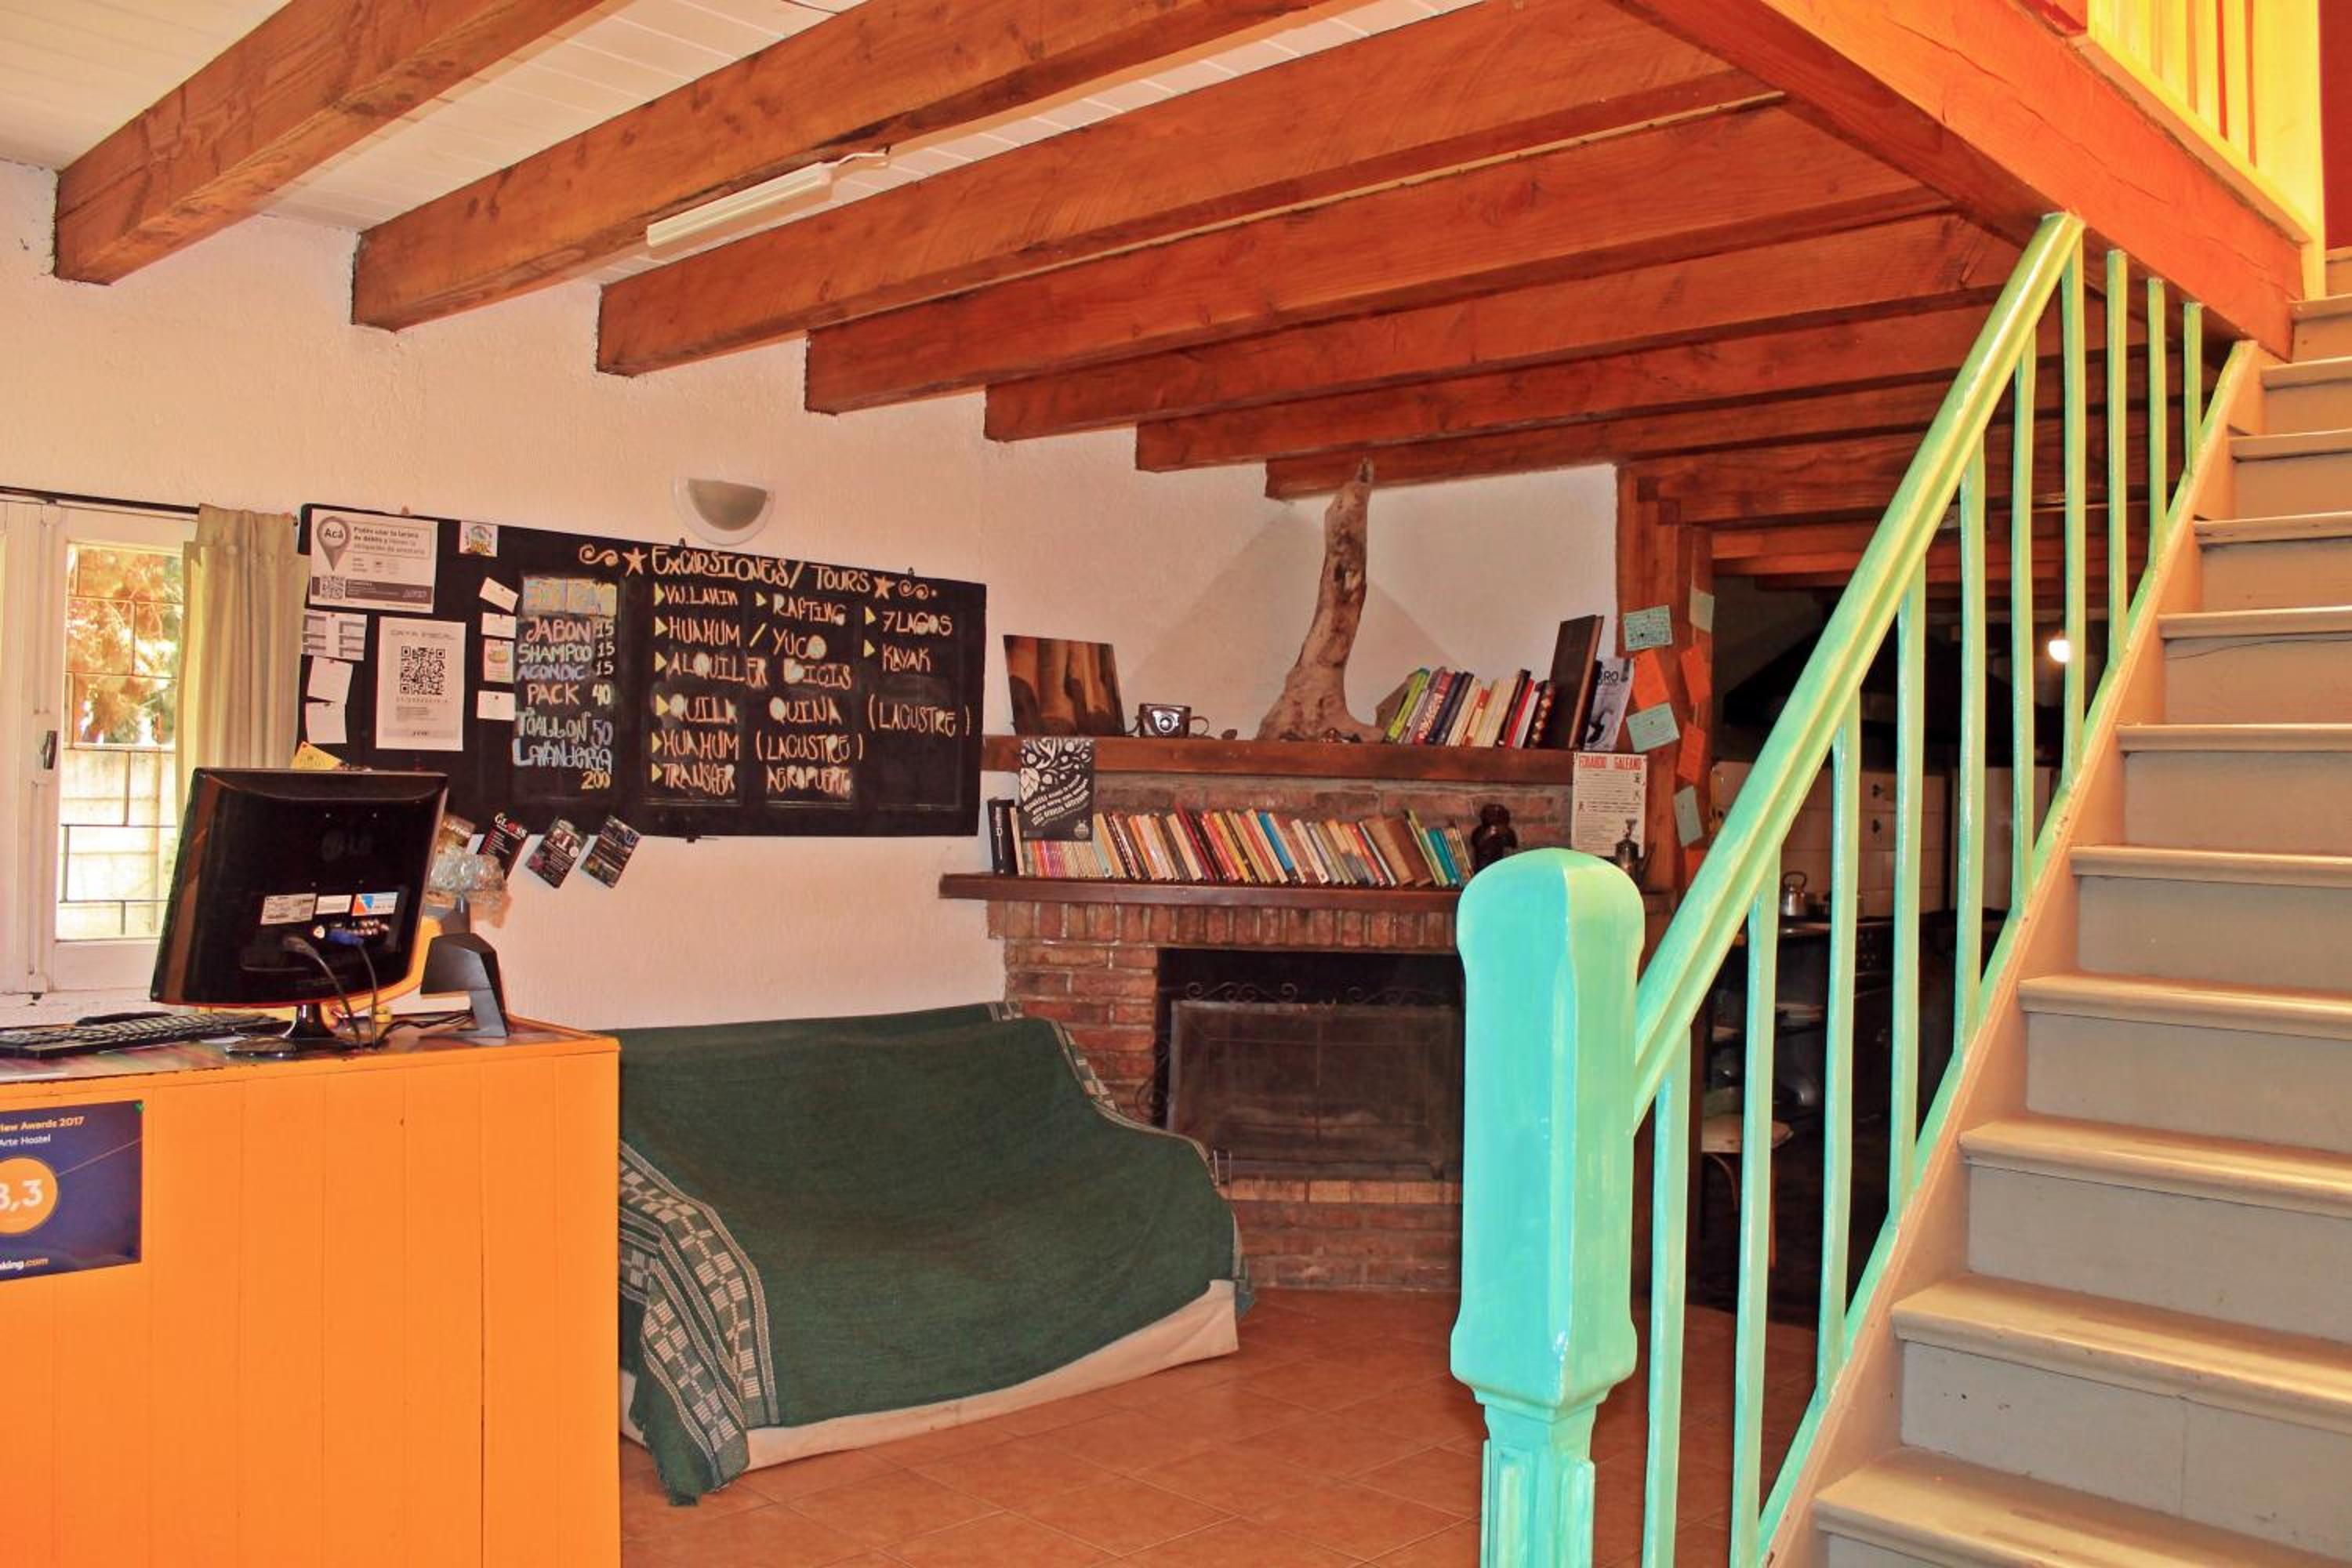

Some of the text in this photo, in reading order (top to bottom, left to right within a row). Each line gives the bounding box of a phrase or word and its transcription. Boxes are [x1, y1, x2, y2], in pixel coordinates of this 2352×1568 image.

[324, 528, 344, 539] Acá
[809, 565, 871, 593] TOURS
[773, 593, 847, 626] RAFTING
[526, 616, 592, 642] JABON
[669, 616, 741, 648] HUAHUM
[773, 627, 827, 660] YUCO
[517, 643, 593, 663] SHAMPOO
[597, 642, 615, 658] 15
[882, 643, 931, 672] KAYAK
[596, 661, 614, 676] 15
[667, 652, 768, 689] ALQUILER
[527, 683, 580, 706] PACK
[769, 696, 843, 725] QUINA
[590, 719, 613, 750] 50
[661, 729, 739, 761] HUAHUM
[581, 770, 611, 789] 200
[662, 761, 735, 796] TRANSFER
[0, 1116, 85, 1133] iew Awards 2017
[20, 1134, 51, 1145] Hostel
